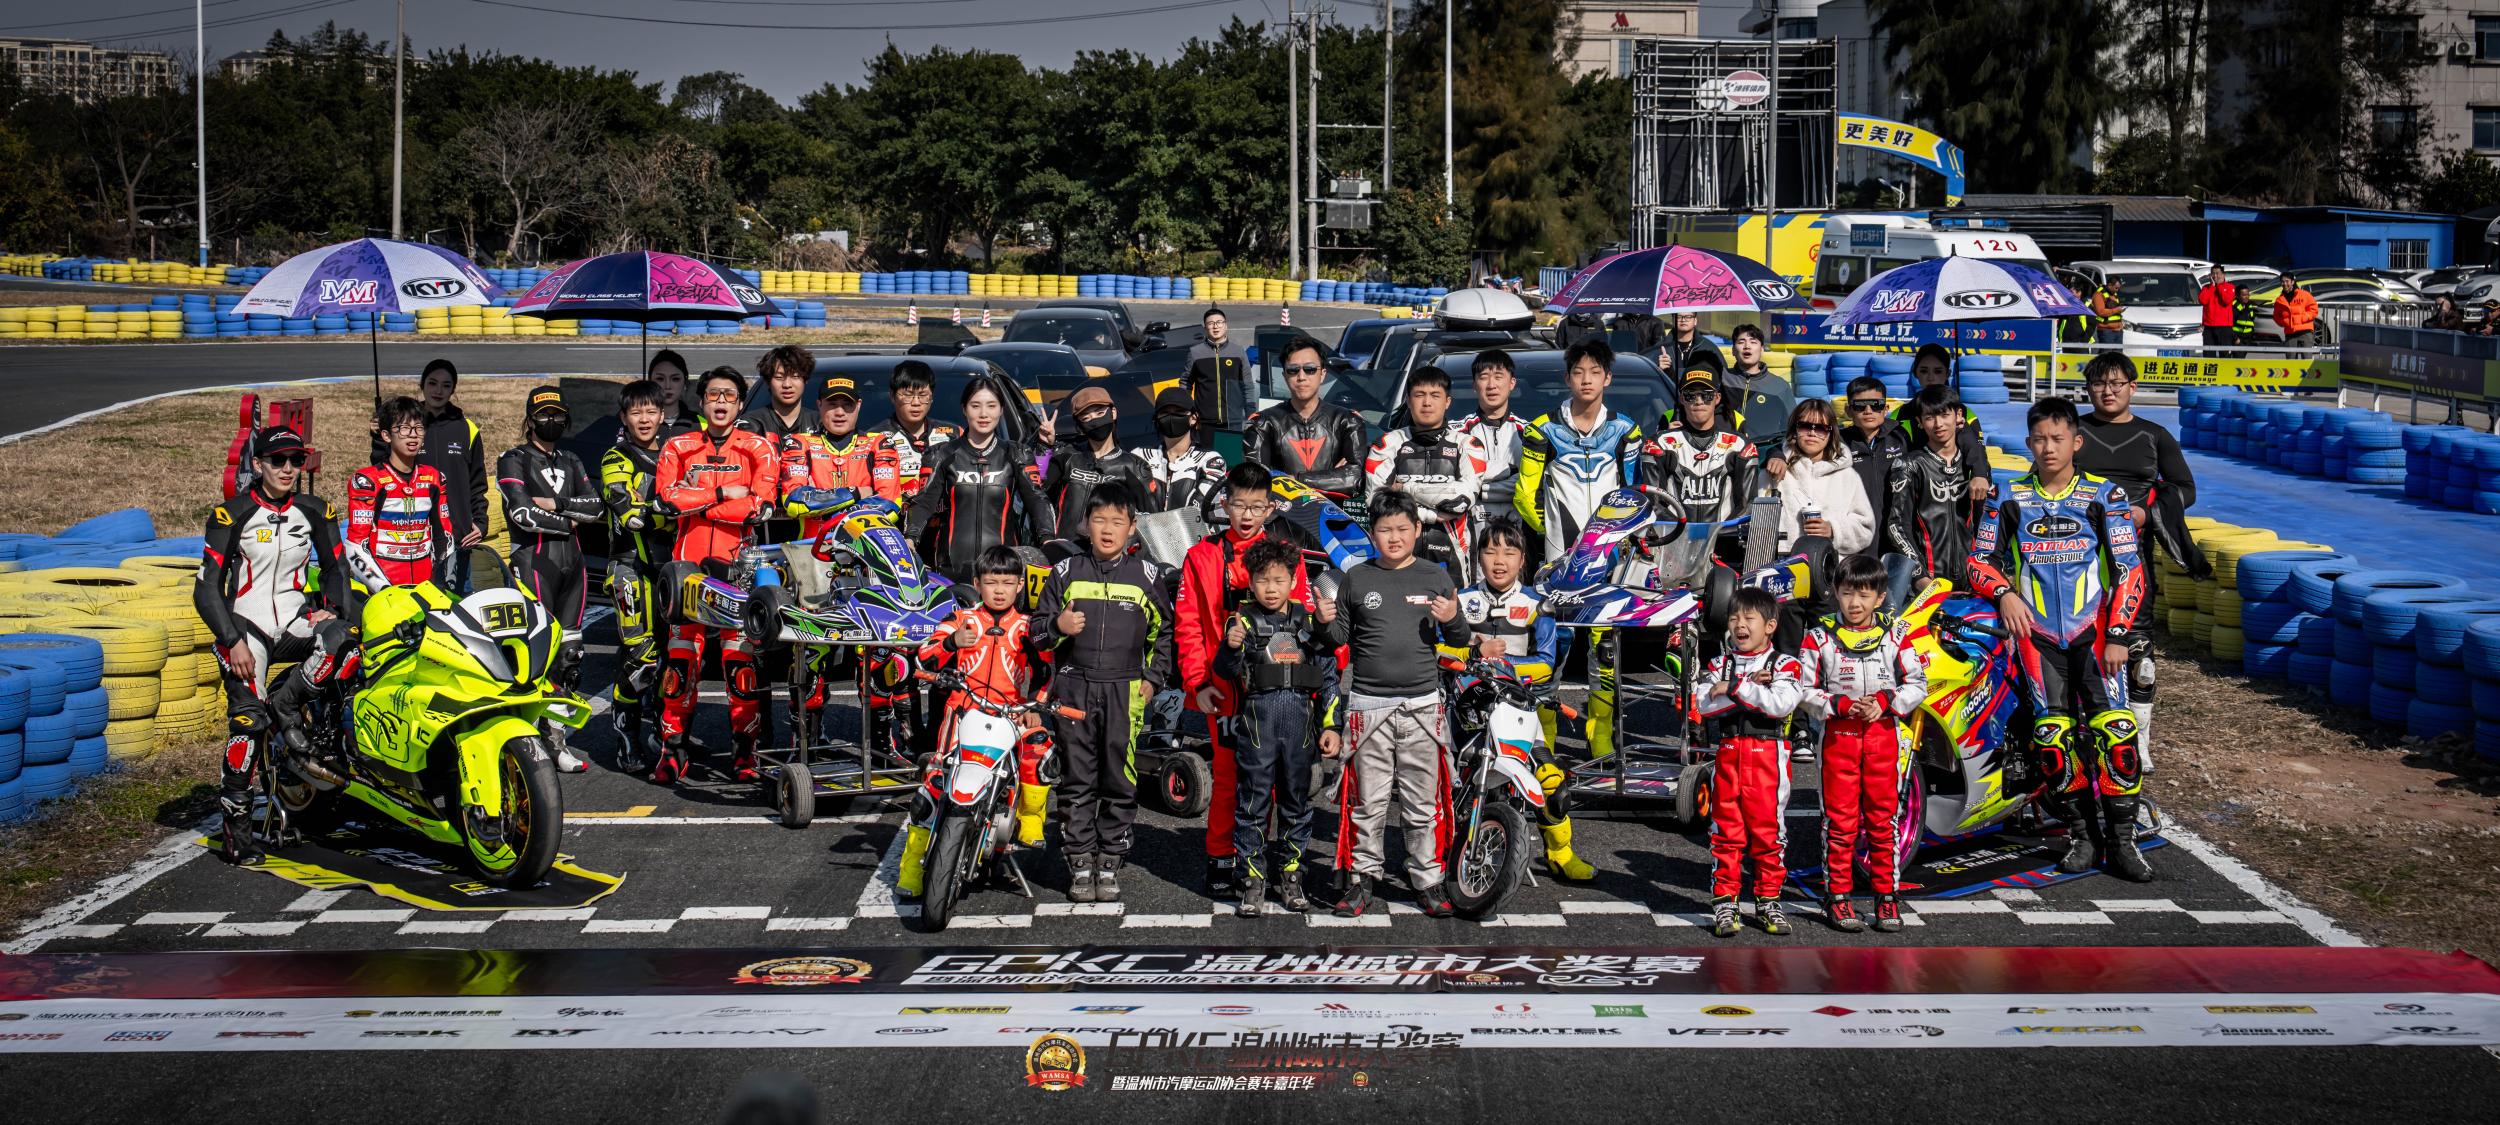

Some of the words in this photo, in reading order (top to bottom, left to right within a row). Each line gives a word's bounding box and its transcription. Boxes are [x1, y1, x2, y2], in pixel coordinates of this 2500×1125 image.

[1843, 122, 1914, 148] 更美好
[1973, 239, 2018, 252] 120
[319, 278, 377, 305] MM
[2031, 283, 2069, 307] 41
[1872, 289, 1925, 313] MM
[1897, 336, 1919, 344] slowly
[2144, 361, 2218, 376] 进站通道
[956, 471, 1003, 484] KYT
[856, 516, 892, 529] 20
[256, 529, 272, 543] 12
[2111, 528, 2132, 536] LIQUI
[2111, 535, 2133, 543] MOLY
[2021, 539, 2089, 552] BATTLAX
[2029, 553, 2084, 564] BRIDGESTONE
[351, 553, 379, 579] KYT
[683, 581, 697, 613] 20
[913, 951, 1186, 974] GPKC
[1193, 951, 1705, 974] 温州城市大奖赛
